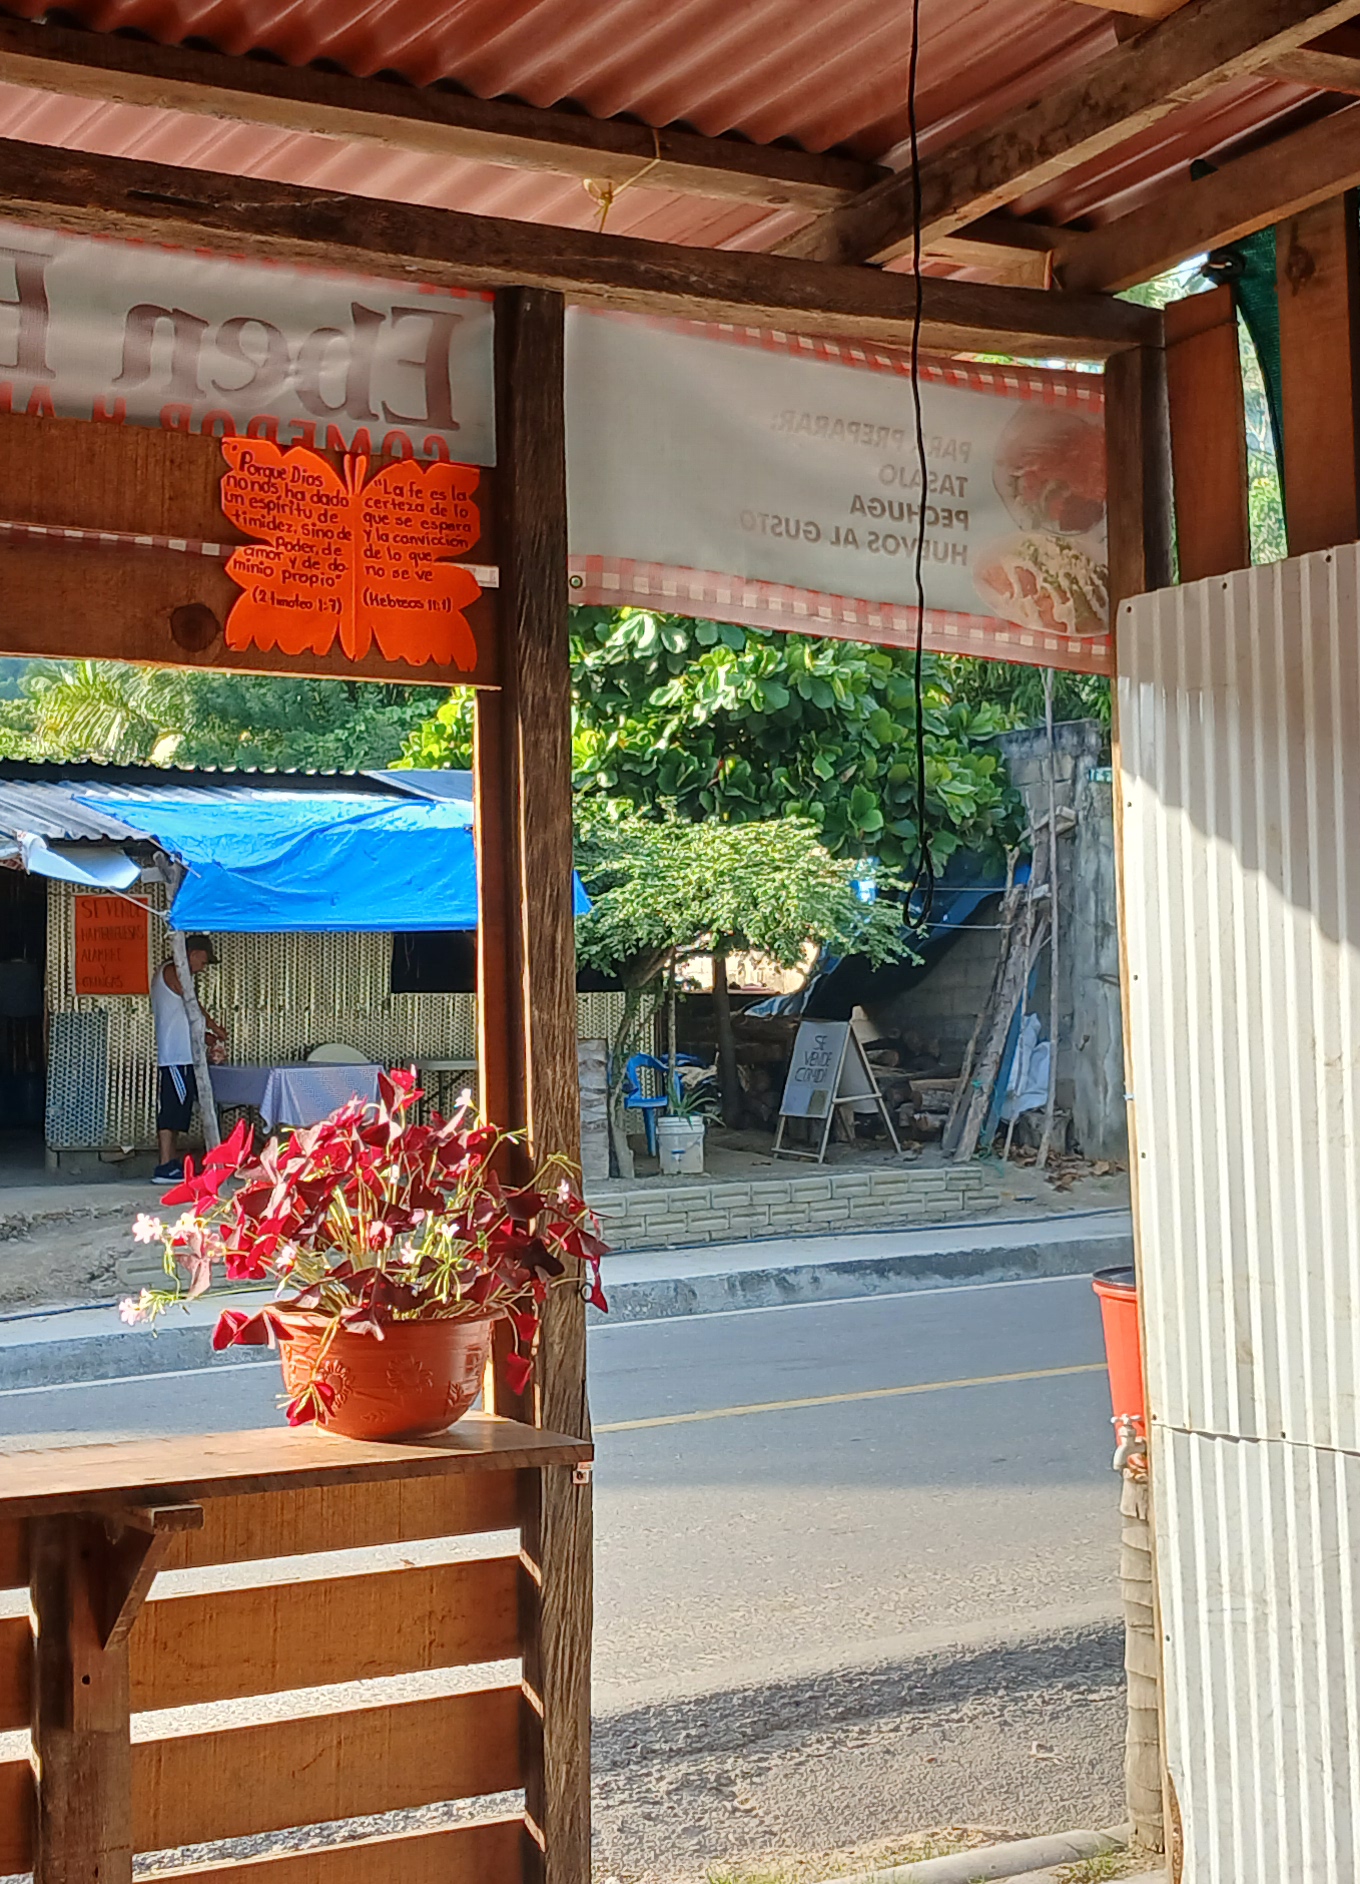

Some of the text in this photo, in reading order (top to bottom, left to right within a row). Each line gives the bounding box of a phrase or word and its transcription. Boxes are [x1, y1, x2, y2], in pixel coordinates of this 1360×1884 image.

[291, 465, 324, 487] Dios
[285, 482, 306, 501] ha
[310, 489, 349, 508] dado
[408, 481, 423, 499] fe
[430, 490, 447, 501] es
[451, 484, 467, 502] la
[225, 491, 245, 506] un
[317, 508, 339, 525] de
[364, 497, 469, 519] certeza de lo
[362, 511, 389, 528] que
[395, 516, 412, 528] se
[337, 525, 352, 541] de
[375, 526, 390, 542] la
[393, 532, 469, 549] convicción
[243, 547, 282, 562] amor
[301, 556, 321, 570] de
[321, 541, 342, 556] de
[363, 543, 433, 569] de lo que
[233, 558, 275, 578] minio
[365, 565, 434, 582] no se ve
[252, 585, 268, 604] (2
[813, 1035, 828, 1050] SE
